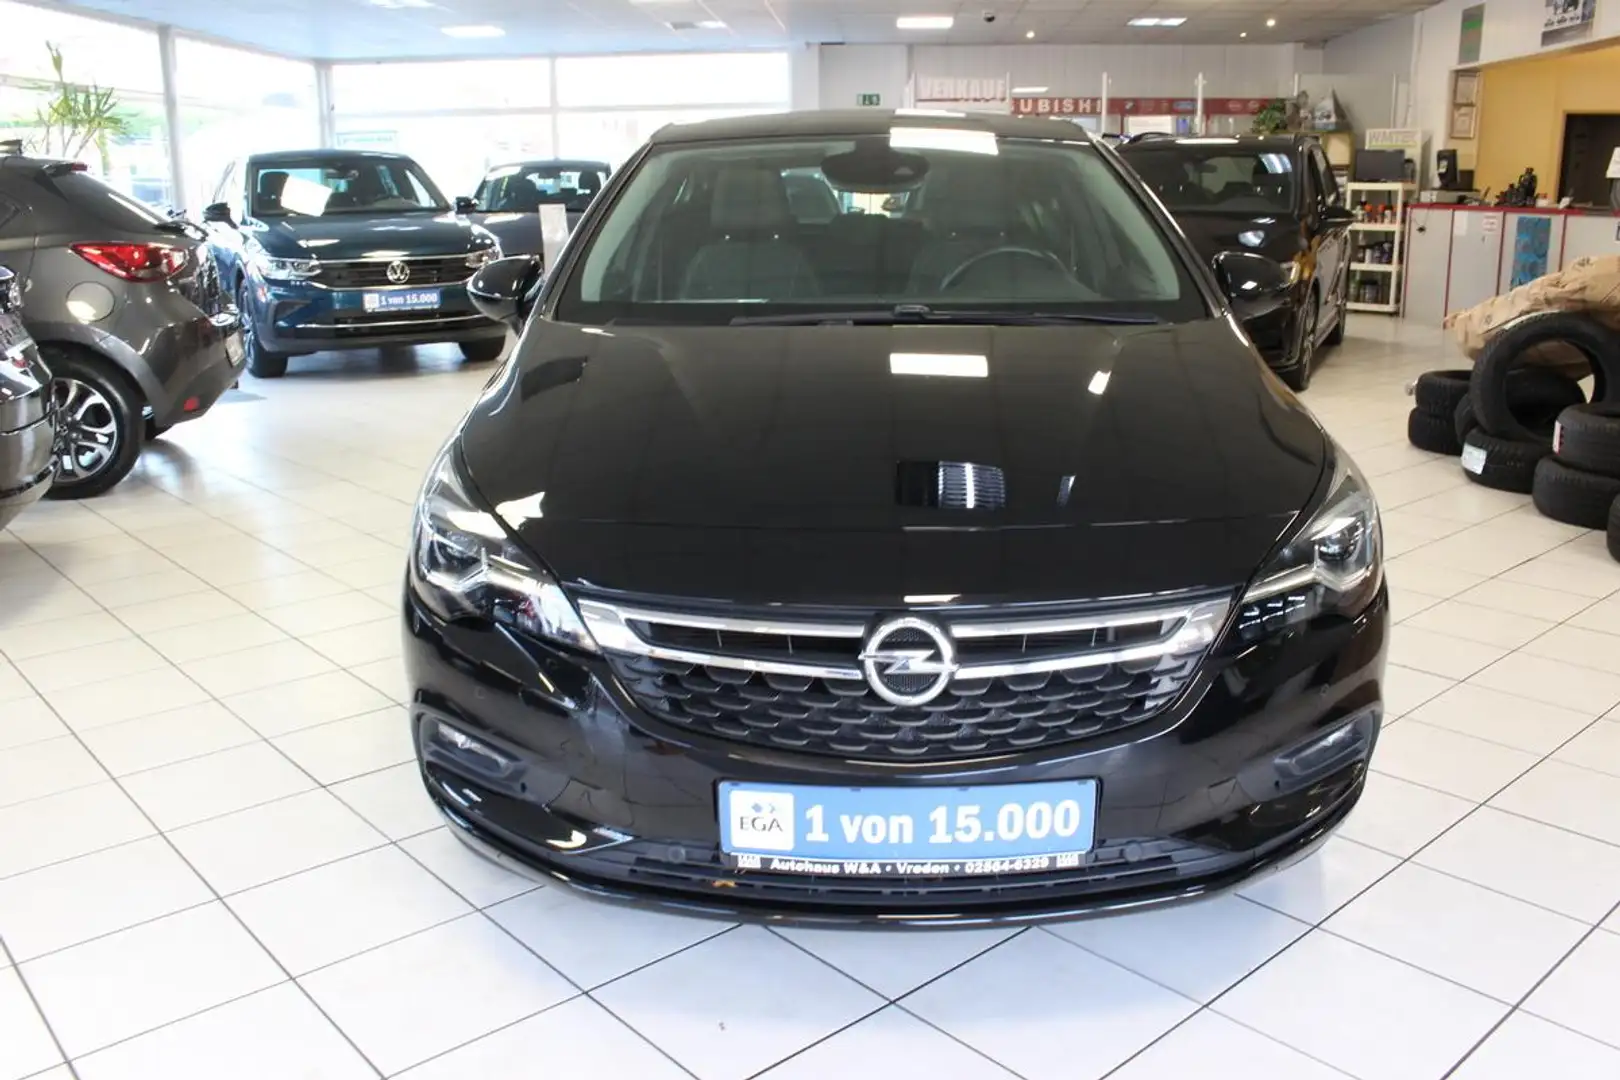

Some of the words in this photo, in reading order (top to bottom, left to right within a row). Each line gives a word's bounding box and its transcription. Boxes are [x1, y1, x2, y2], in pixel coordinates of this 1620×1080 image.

[739, 816, 783, 833] EGA
[805, 804, 829, 842] 1
[839, 814, 914, 844] von
[928, 799, 1080, 844] 15.000
[770, 857, 840, 874] Autohaus
[843, 861, 882, 875] W&A
[896, 861, 950, 875] Vreden
